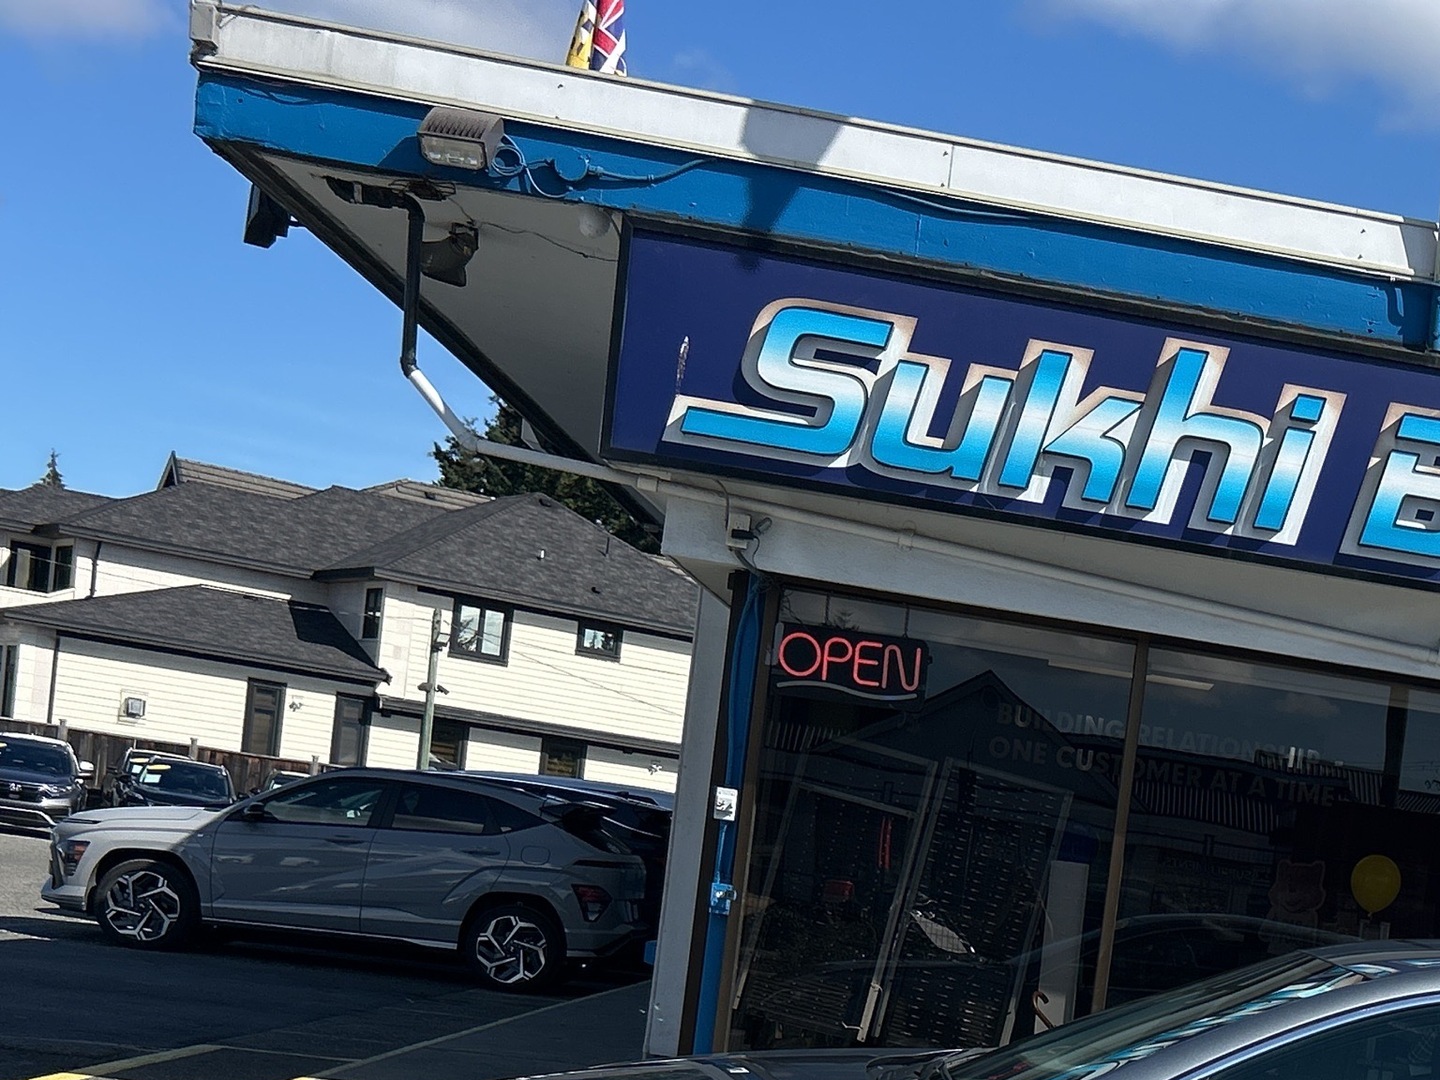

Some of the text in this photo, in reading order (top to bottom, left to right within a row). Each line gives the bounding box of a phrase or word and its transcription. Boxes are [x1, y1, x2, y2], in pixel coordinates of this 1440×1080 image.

[662, 298, 1347, 546] Sukhi
[778, 631, 922, 693] OPEN
[996, 702, 1125, 740] BUILDING
[989, 735, 1049, 765] ONE
[1210, 769, 1243, 793] AT
[1247, 776, 1267, 798] A
[1274, 778, 1335, 807] TIME
